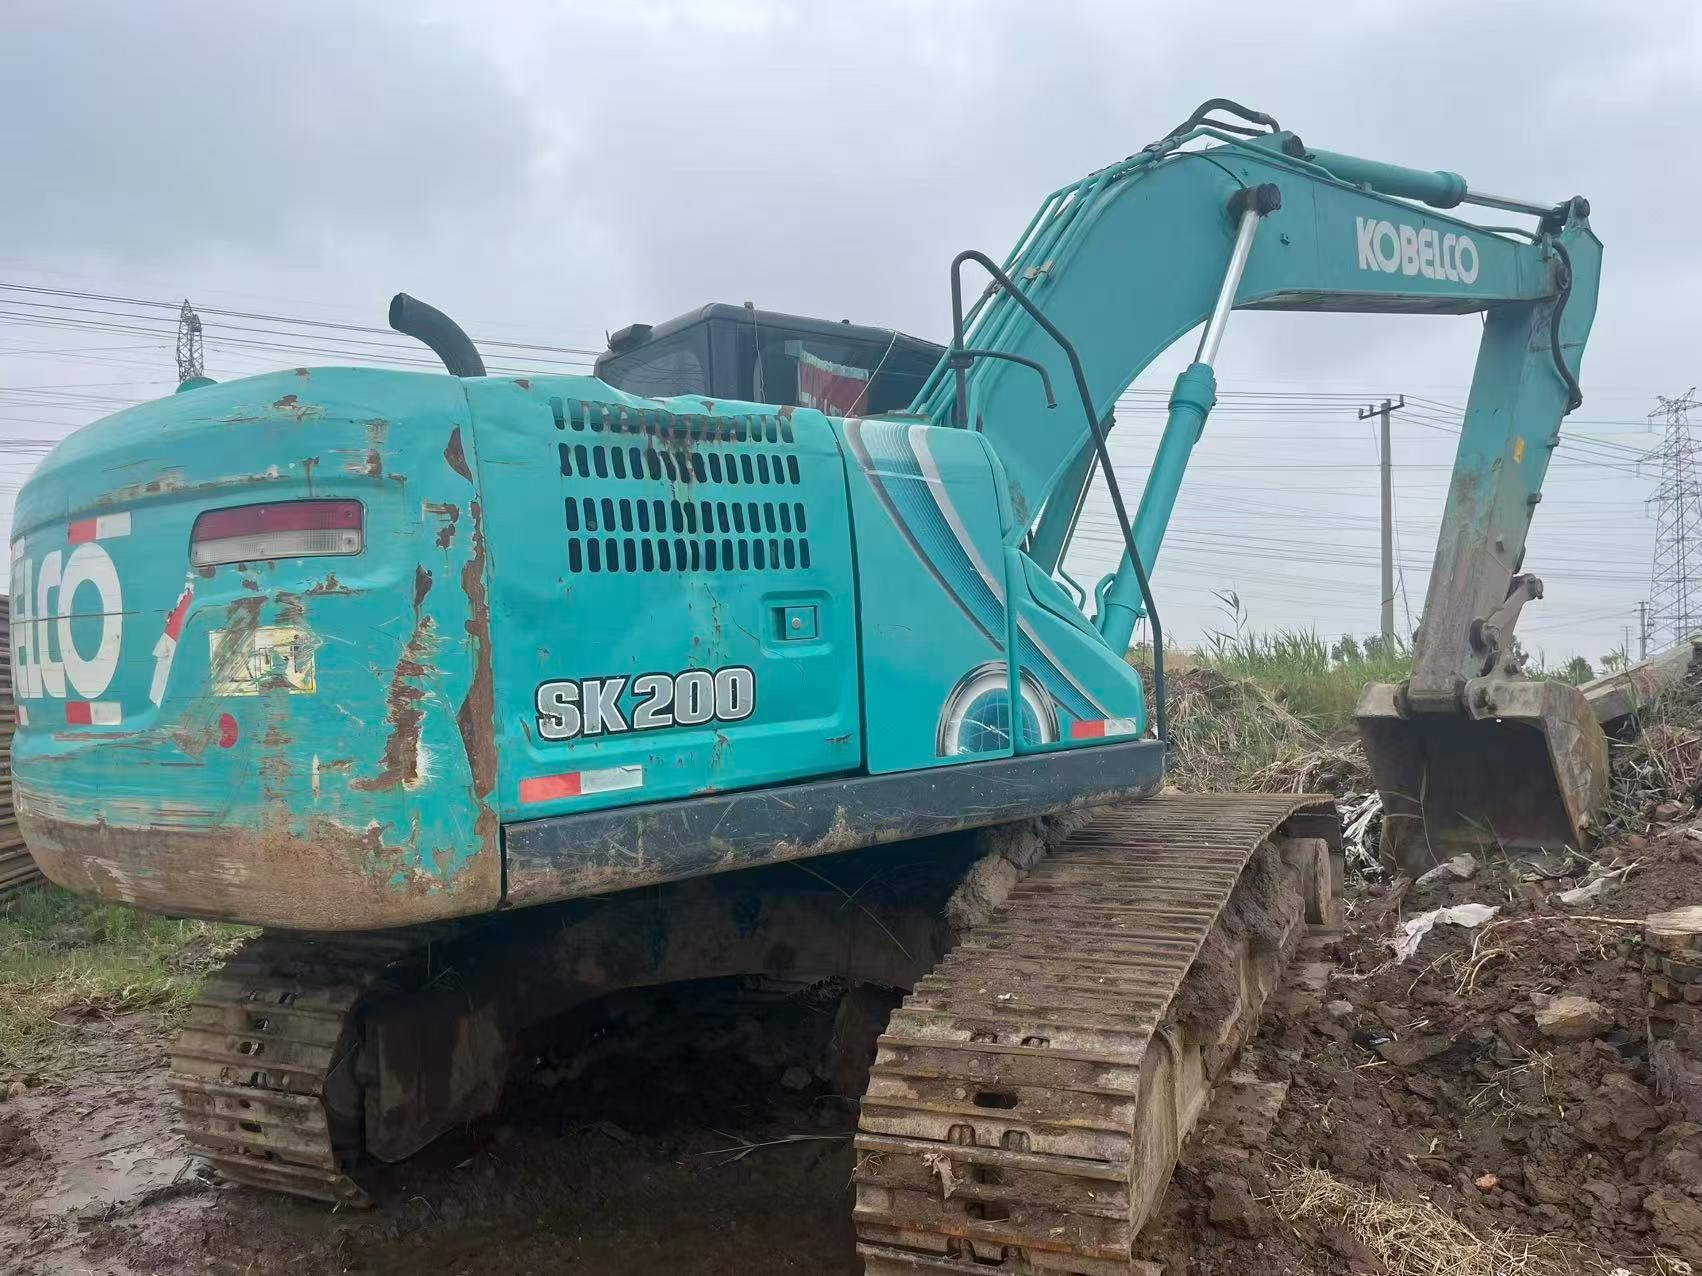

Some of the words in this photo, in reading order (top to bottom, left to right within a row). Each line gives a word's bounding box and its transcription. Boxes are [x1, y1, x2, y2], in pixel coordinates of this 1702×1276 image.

[1356, 216, 1479, 284] KOBELCO
[10, 542, 122, 698] ELCO
[535, 665, 755, 742] SK200
